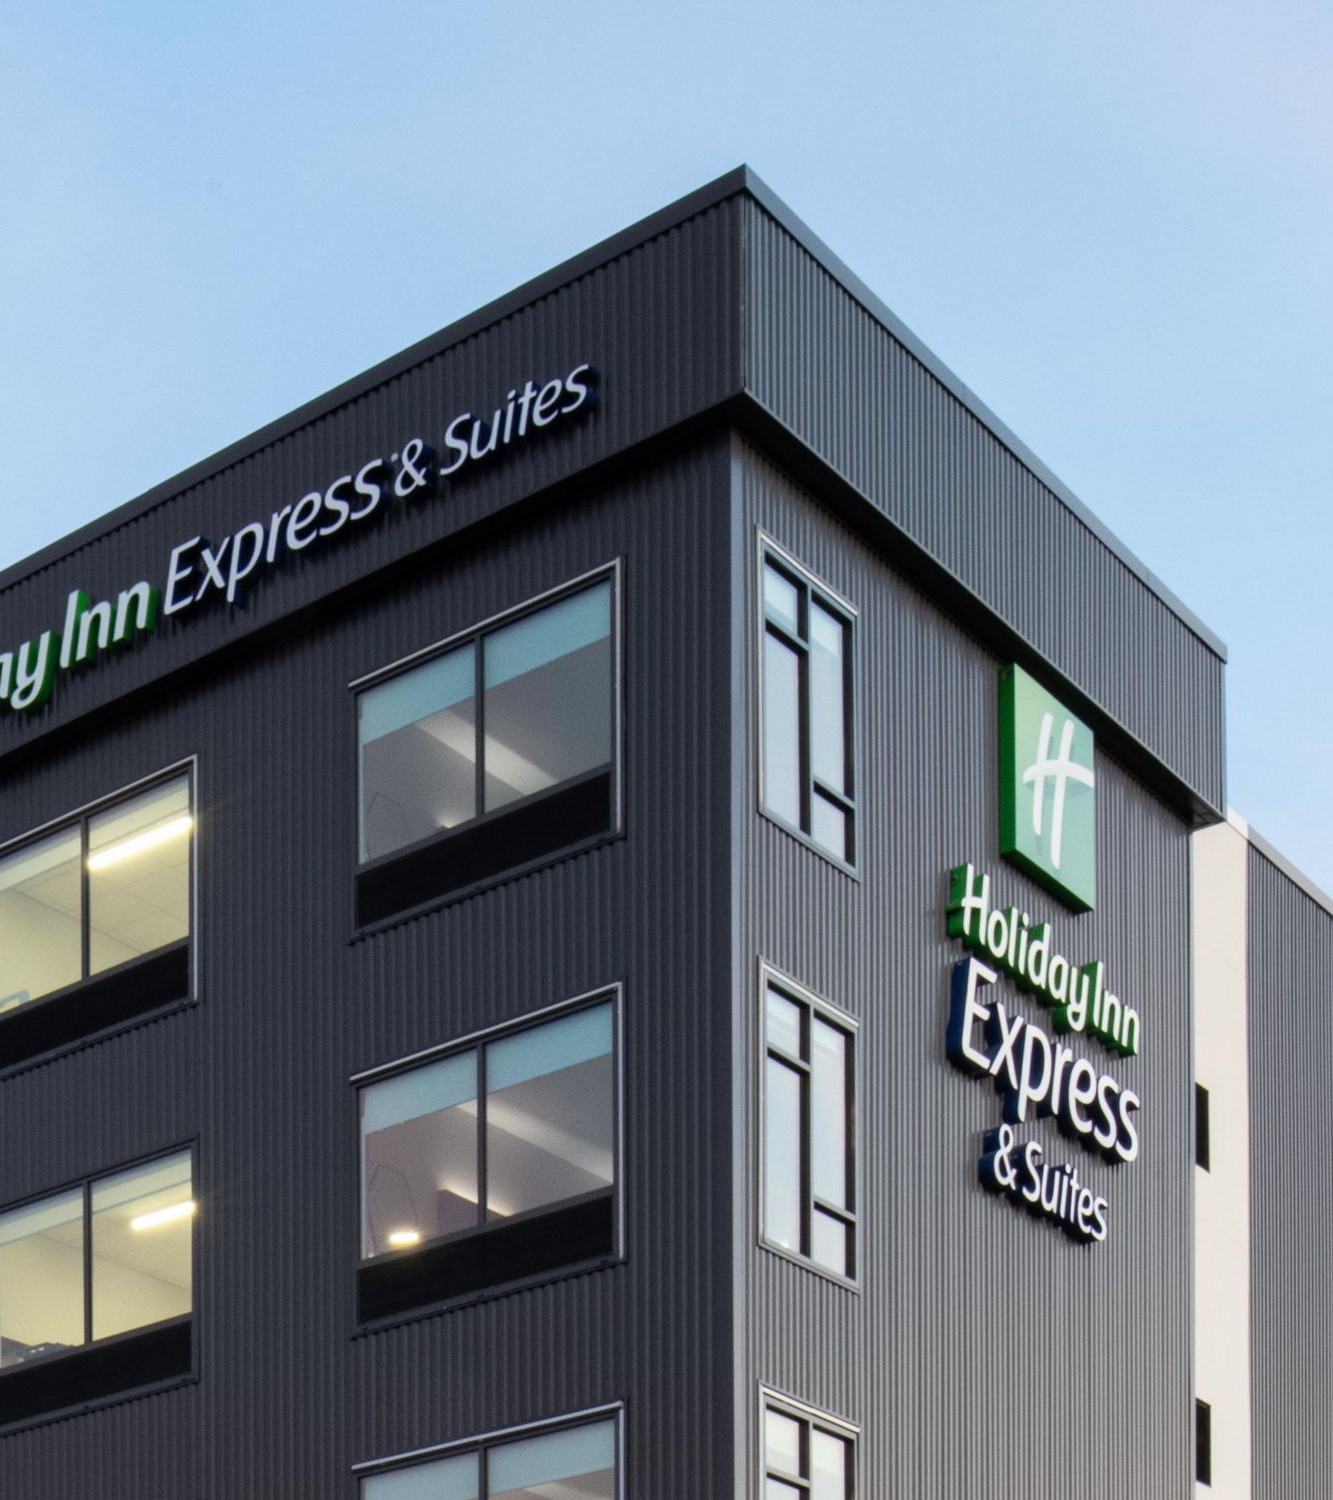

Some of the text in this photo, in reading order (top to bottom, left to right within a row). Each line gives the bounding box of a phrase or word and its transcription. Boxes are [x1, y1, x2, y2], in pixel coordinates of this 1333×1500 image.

[60, 580, 153, 669] Inn
[163, 457, 384, 616] Express
[393, 437, 428, 498] &
[438, 363, 591, 477] Suites
[960, 862, 1140, 1056] Holiday Inn
[961, 956, 1141, 1163] Express
[993, 1122, 1109, 1242] & Suites
